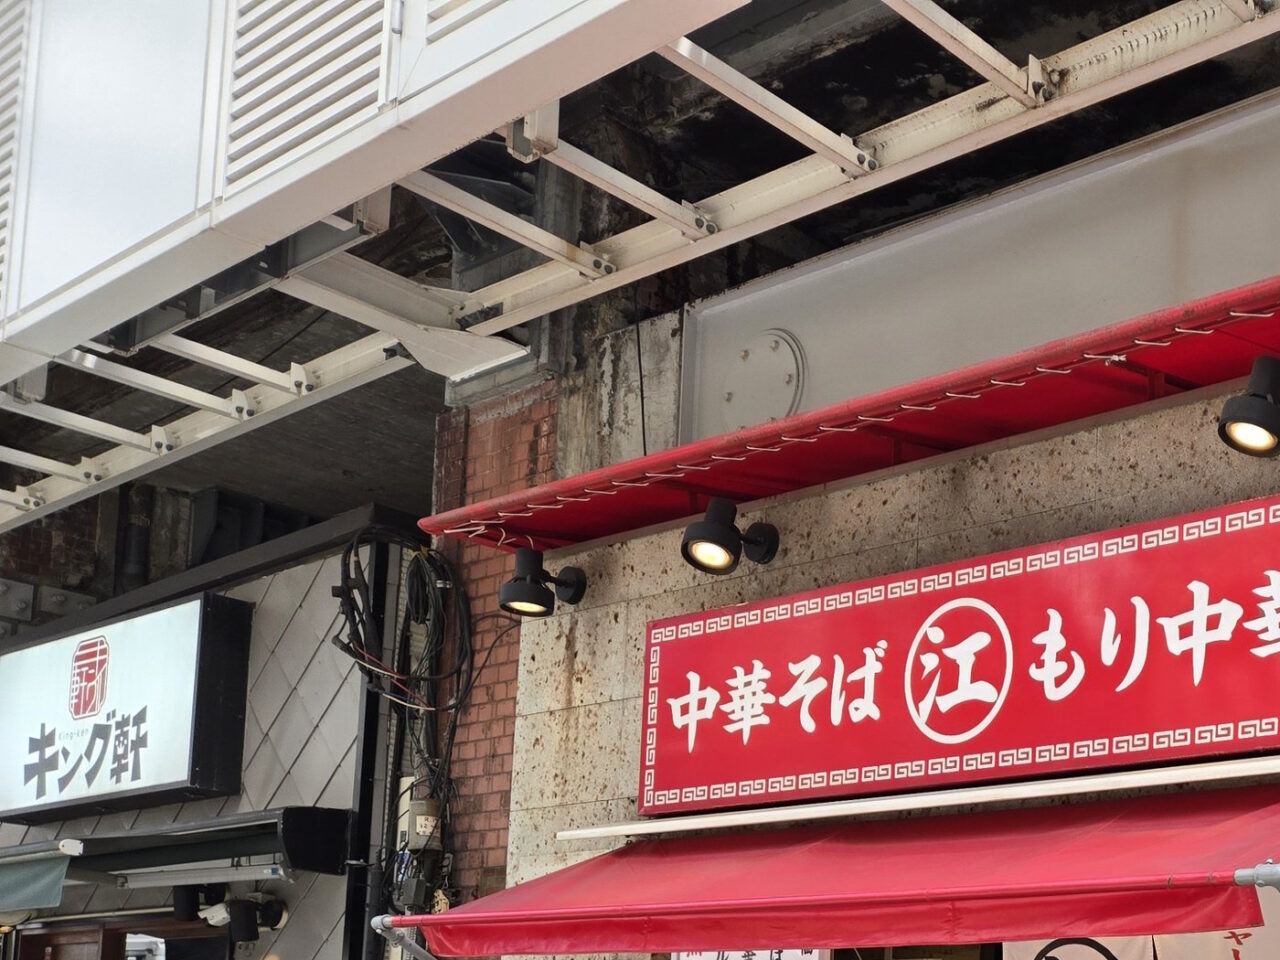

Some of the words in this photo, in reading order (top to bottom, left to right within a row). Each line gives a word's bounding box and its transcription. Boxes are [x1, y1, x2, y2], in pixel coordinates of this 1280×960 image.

[668, 640, 887, 753] 中華そば
[24, 705, 148, 800] キング軒
